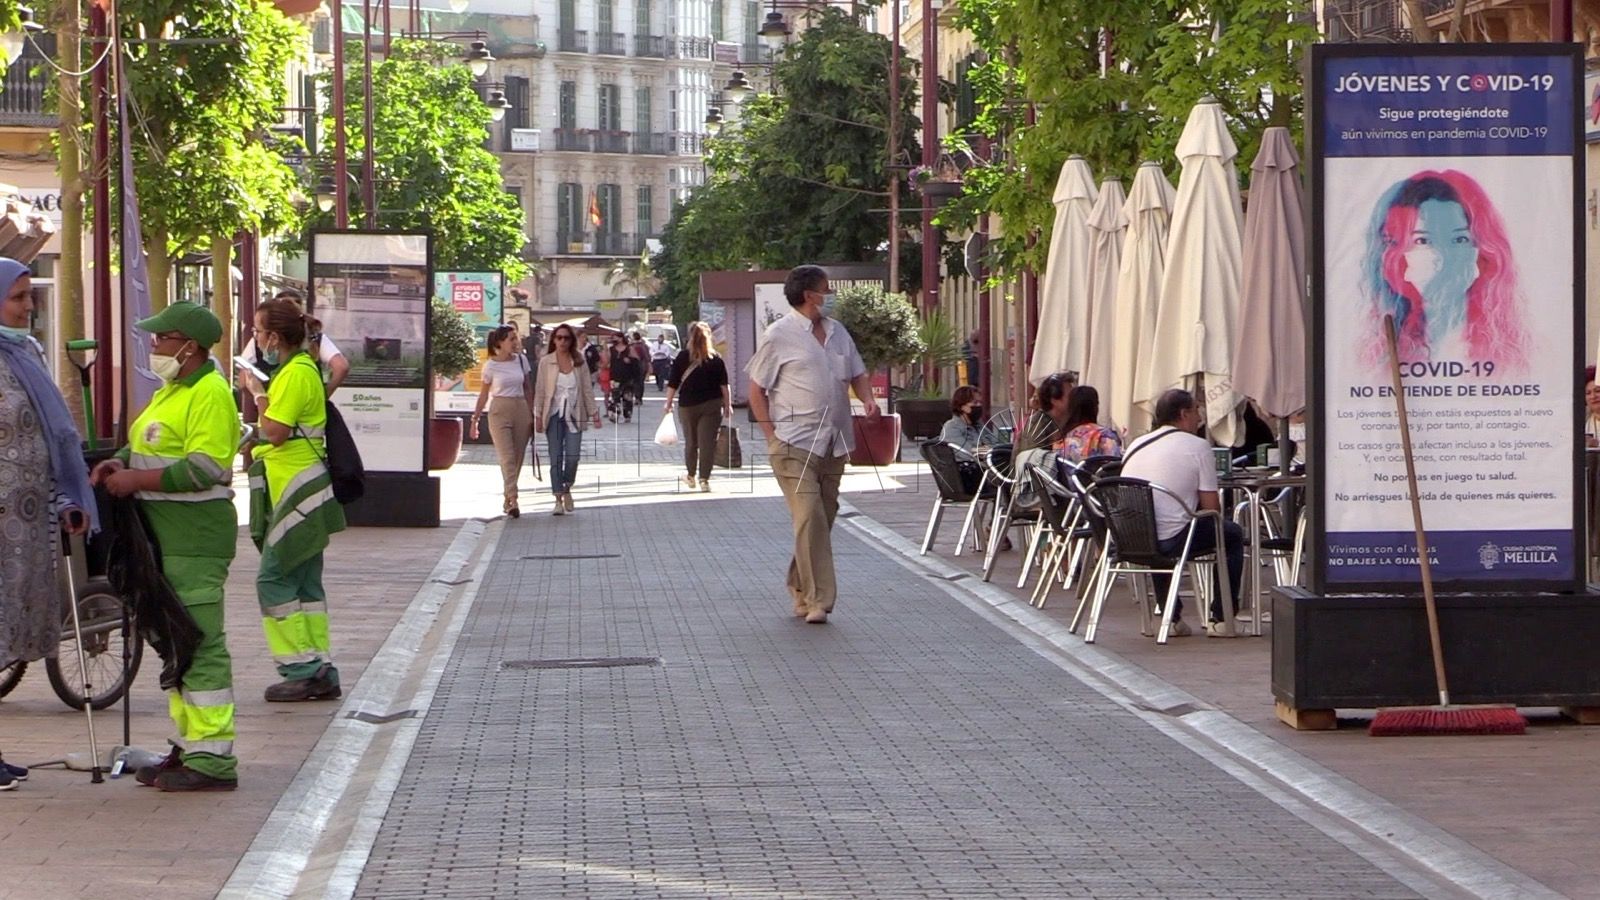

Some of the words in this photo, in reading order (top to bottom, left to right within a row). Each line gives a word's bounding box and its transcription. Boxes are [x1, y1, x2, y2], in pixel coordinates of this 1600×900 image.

[1334, 71, 1431, 93] JÓVENES
[1437, 75, 1451, 92] Y
[1456, 73, 1554, 93] COVID-19
[1379, 107, 1414, 122] Sigue
[1418, 106, 1509, 121] protegiéndote
[1341, 128, 1363, 140] aún
[1366, 128, 1408, 140] vivimos
[1411, 130, 1425, 140] en
[1428, 127, 1486, 141] pandemia
[1489, 126, 1548, 139] COVID-19
[453, 291, 482, 302] ESO
[1398, 360, 1495, 378] COVID-19
[1350, 386, 1374, 398] NO
[1457, 385, 1477, 397] DE
[1482, 384, 1541, 397] EDADES
[1337, 410, 1354, 418] Los
[1355, 409, 1392, 420] jóvenes
[1435, 409, 1462, 418] estáis
[1464, 409, 1512, 420] expuestos
[1513, 408, 1522, 417] al
[1524, 409, 1554, 417] nuevo
[1426, 422, 1442, 432] por
[1445, 421, 1473, 431] tanto,
[1475, 420, 1484, 430] al
[1486, 420, 1530, 432] contagio.
[1338, 441, 1355, 450] Los
[1418, 440, 1454, 450] afectan
[1455, 440, 1488, 449] incluso
[1498, 440, 1513, 449] los
[1513, 439, 1553, 451] jóvenes.
[1439, 454, 1456, 462] con
[1459, 452, 1503, 461] resultado
[1504, 451, 1528, 461] fatal.
[1374, 472, 1389, 482] No
[1444, 472, 1473, 483] juego
[1476, 473, 1486, 481] tu
[1488, 471, 1518, 481] salud.
[1335, 492, 1350, 502] No
[1352, 493, 1403, 504] arriesgues
[1439, 491, 1452, 500] de
[1455, 491, 1494, 502] quienes
[1496, 490, 1516, 500] más
[1518, 490, 1557, 501] quieres.
[1328, 545, 1371, 554] Vivimos
[1396, 544, 1408, 553] el
[1328, 558, 1344, 566] NO
[1394, 557, 1440, 565] GUARIA
[1503, 551, 1558, 564] MELILLA
